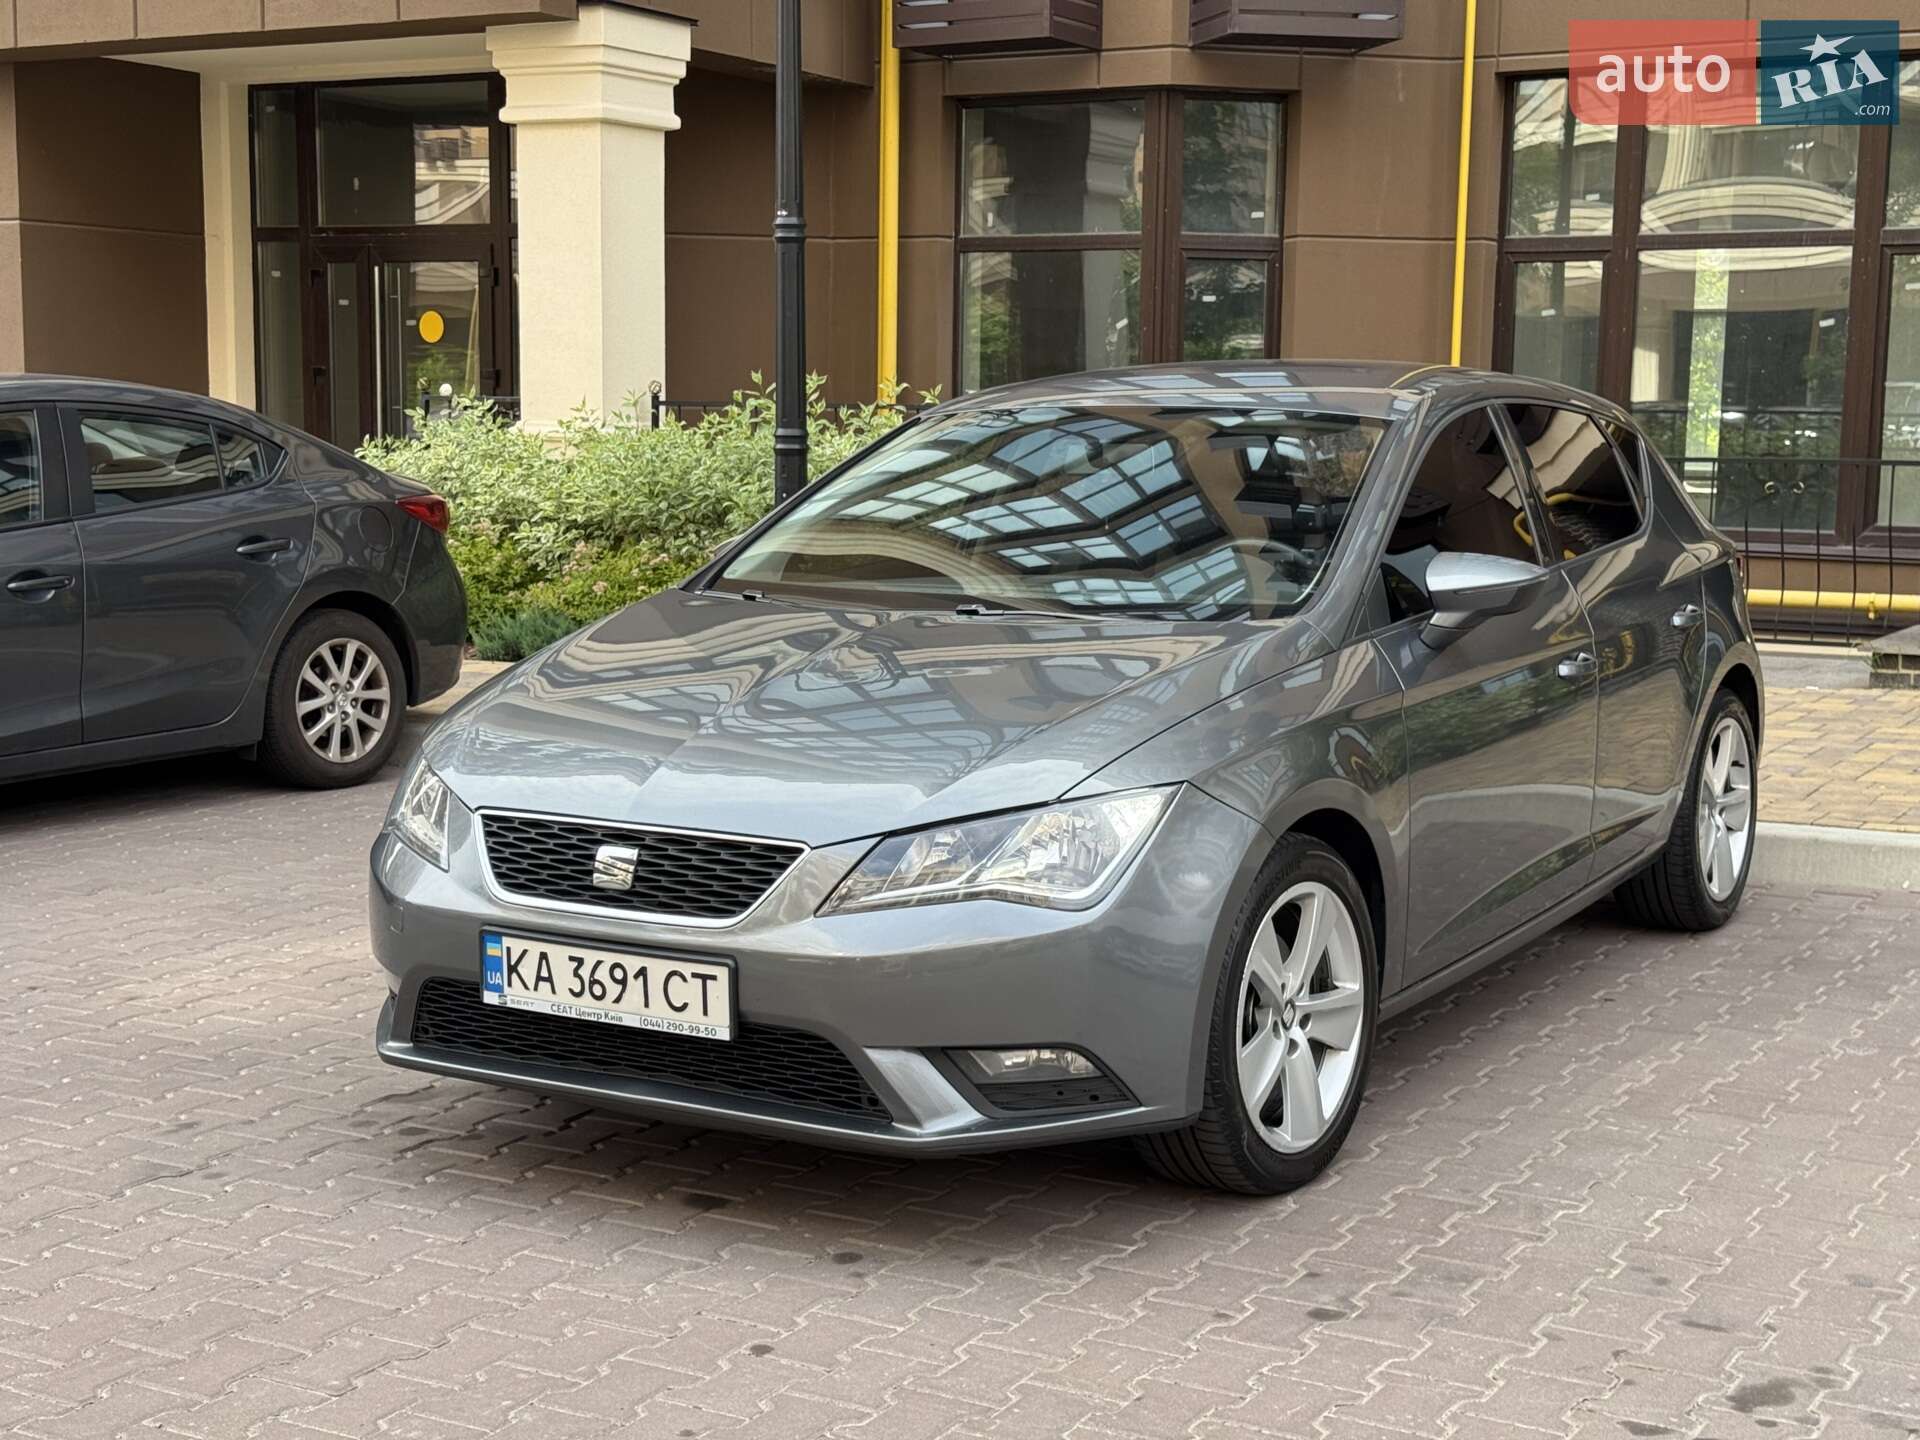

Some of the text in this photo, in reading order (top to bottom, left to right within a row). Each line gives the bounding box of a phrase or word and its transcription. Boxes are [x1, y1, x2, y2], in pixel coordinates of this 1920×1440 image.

[488, 970, 502, 986] UA
[506, 946, 718, 1017] KA 3691 CT
[509, 998, 535, 1008] SEAT
[575, 1007, 603, 1021] Центр
[604, 1011, 623, 1023] Київ
[639, 1016, 717, 1037] (044) 290-99-50
